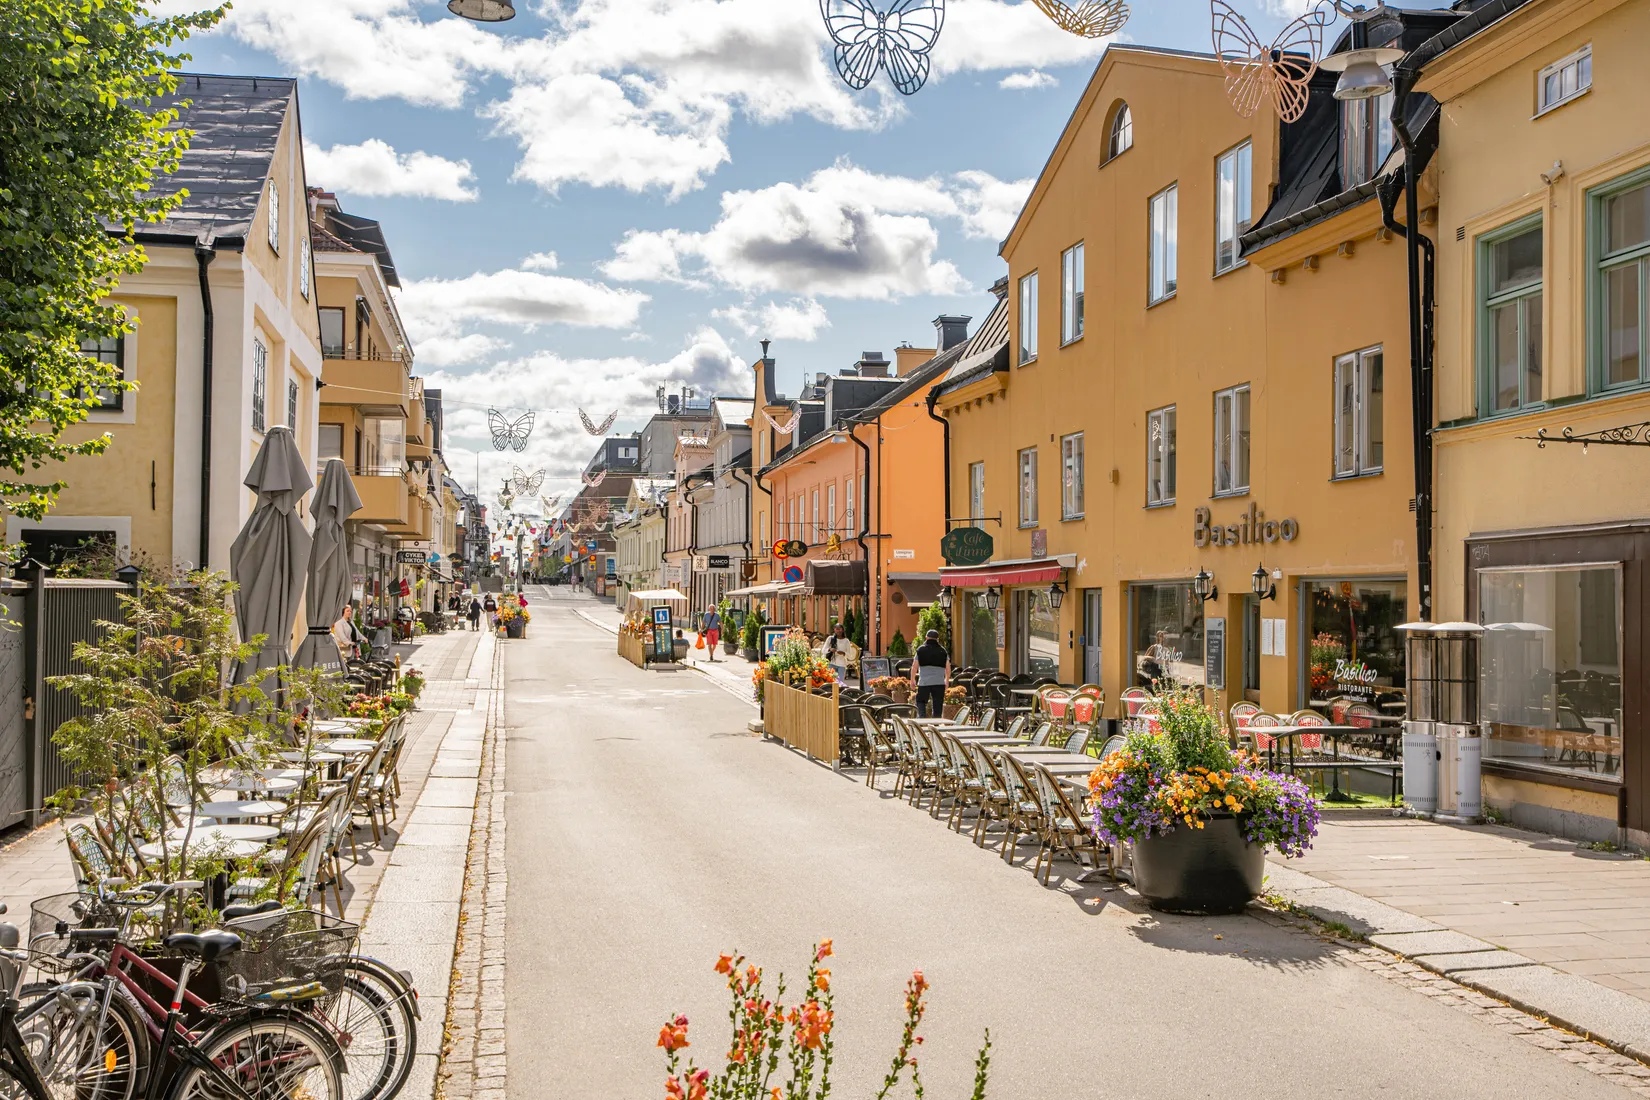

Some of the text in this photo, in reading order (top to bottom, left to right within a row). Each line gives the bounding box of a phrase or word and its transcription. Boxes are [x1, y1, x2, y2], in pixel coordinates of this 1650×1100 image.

[1194, 501, 1299, 548] Basilico
[1156, 643, 1183, 662] Basilico
[1333, 658, 1378, 683] Basilico
[1338, 683, 1373, 695] RISTORANTE
